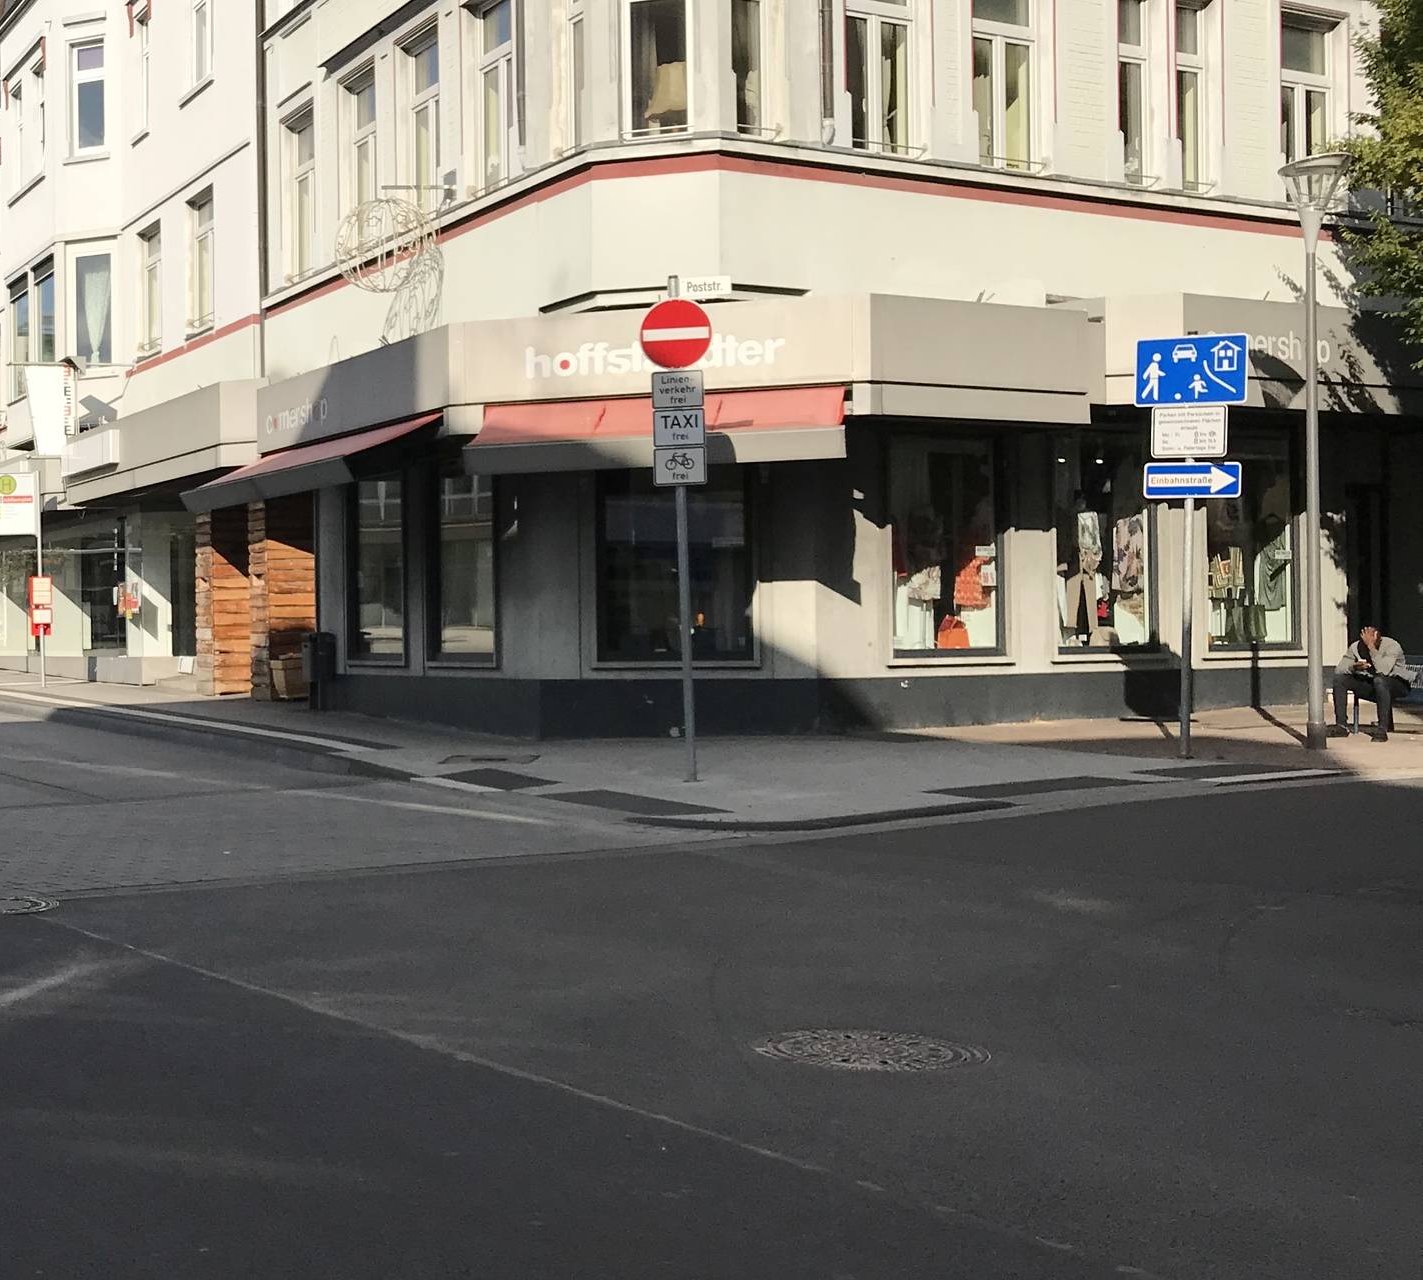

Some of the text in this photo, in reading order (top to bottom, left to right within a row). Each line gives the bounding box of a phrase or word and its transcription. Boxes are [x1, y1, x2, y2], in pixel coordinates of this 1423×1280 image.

[687, 280, 723, 293] Poststr.
[525, 333, 786, 380] hoffstdter
[659, 385, 697, 396] verkehr
[670, 396, 686, 405] frei
[660, 414, 698, 429] TAXI
[672, 432, 689, 441] frei
[672, 471, 688, 481] frei
[1151, 476, 1213, 485] Einbahnstraße
